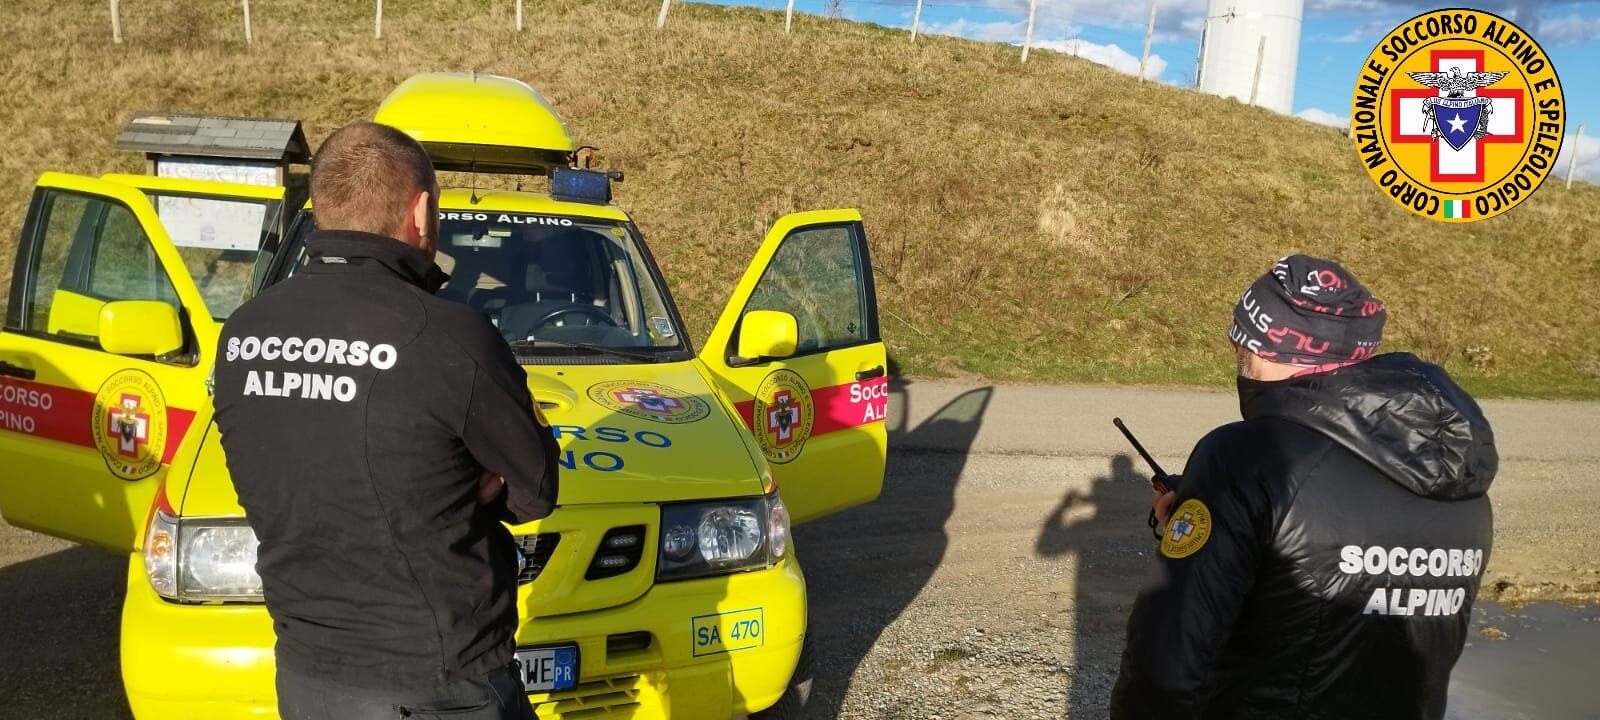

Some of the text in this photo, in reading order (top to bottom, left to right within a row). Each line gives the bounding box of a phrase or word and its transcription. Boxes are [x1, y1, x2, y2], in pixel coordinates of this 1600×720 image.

[497, 214, 573, 226] ALPINO
[226, 336, 397, 370] SOCCORSO
[0, 384, 52, 410] ORSO
[243, 370, 356, 402] ALPINO
[1339, 545, 1483, 577] SOCCORSO
[1363, 587, 1465, 616] ALPINO
[697, 619, 760, 646] SA 470
[555, 666, 571, 682] PR
